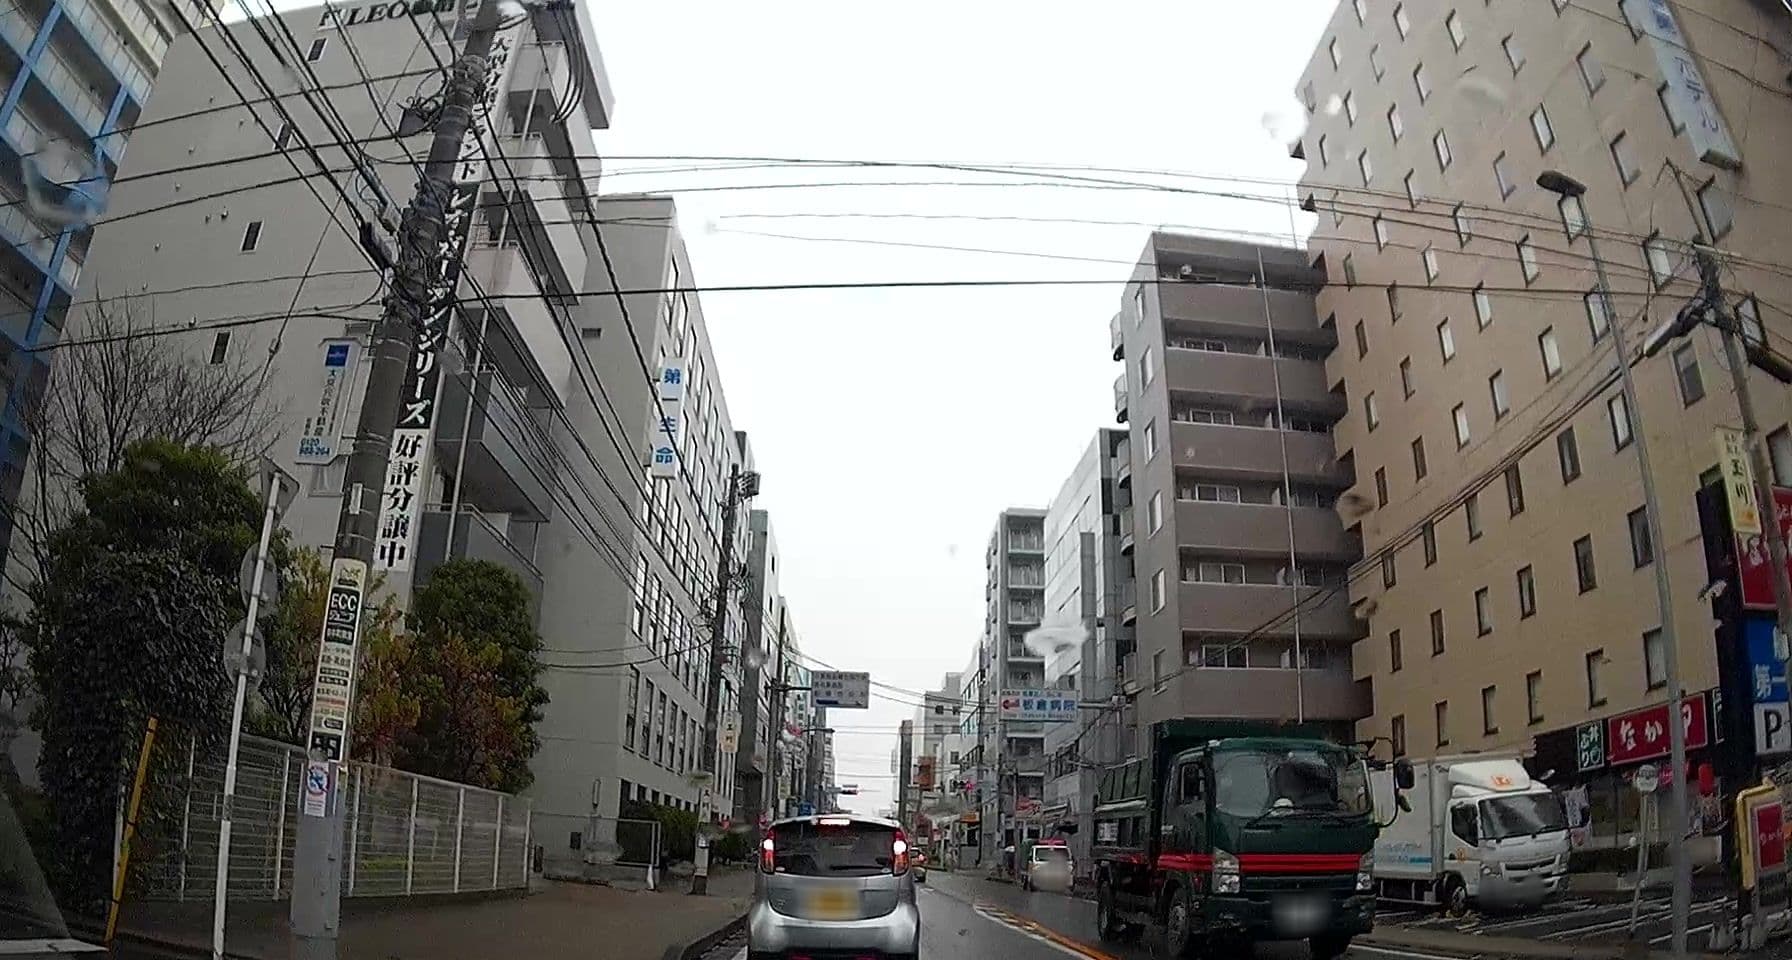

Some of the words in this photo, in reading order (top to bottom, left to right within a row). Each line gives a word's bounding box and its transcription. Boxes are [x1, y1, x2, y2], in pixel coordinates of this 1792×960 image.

[655, 368, 681, 464] 第一生命
[379, 434, 422, 568] 好評分譲中
[330, 593, 357, 612] ECC
[1023, 699, 1075, 711] 板倉病院
[1764, 708, 1782, 749] P
